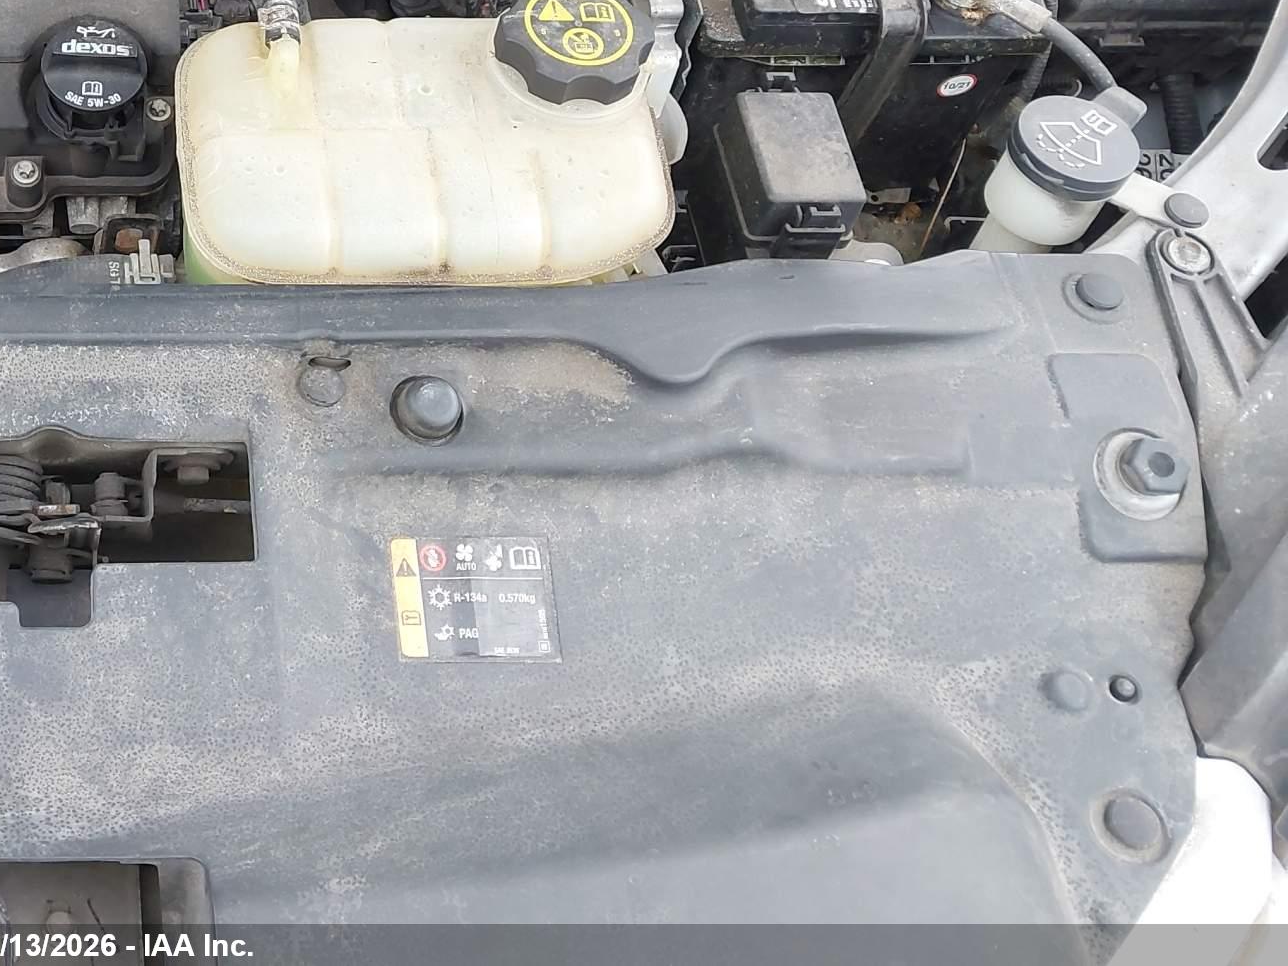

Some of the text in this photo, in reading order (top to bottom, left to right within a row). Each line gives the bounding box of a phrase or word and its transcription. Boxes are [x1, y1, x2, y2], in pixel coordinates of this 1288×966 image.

[61, 39, 130, 57] dexos
[943, 81, 971, 90] 10/21
[64, 91, 122, 108] SAE 5W-30
[455, 562, 477, 571] AUTO
[453, 592, 488, 603] R-134a
[458, 628, 479, 639] PAG
